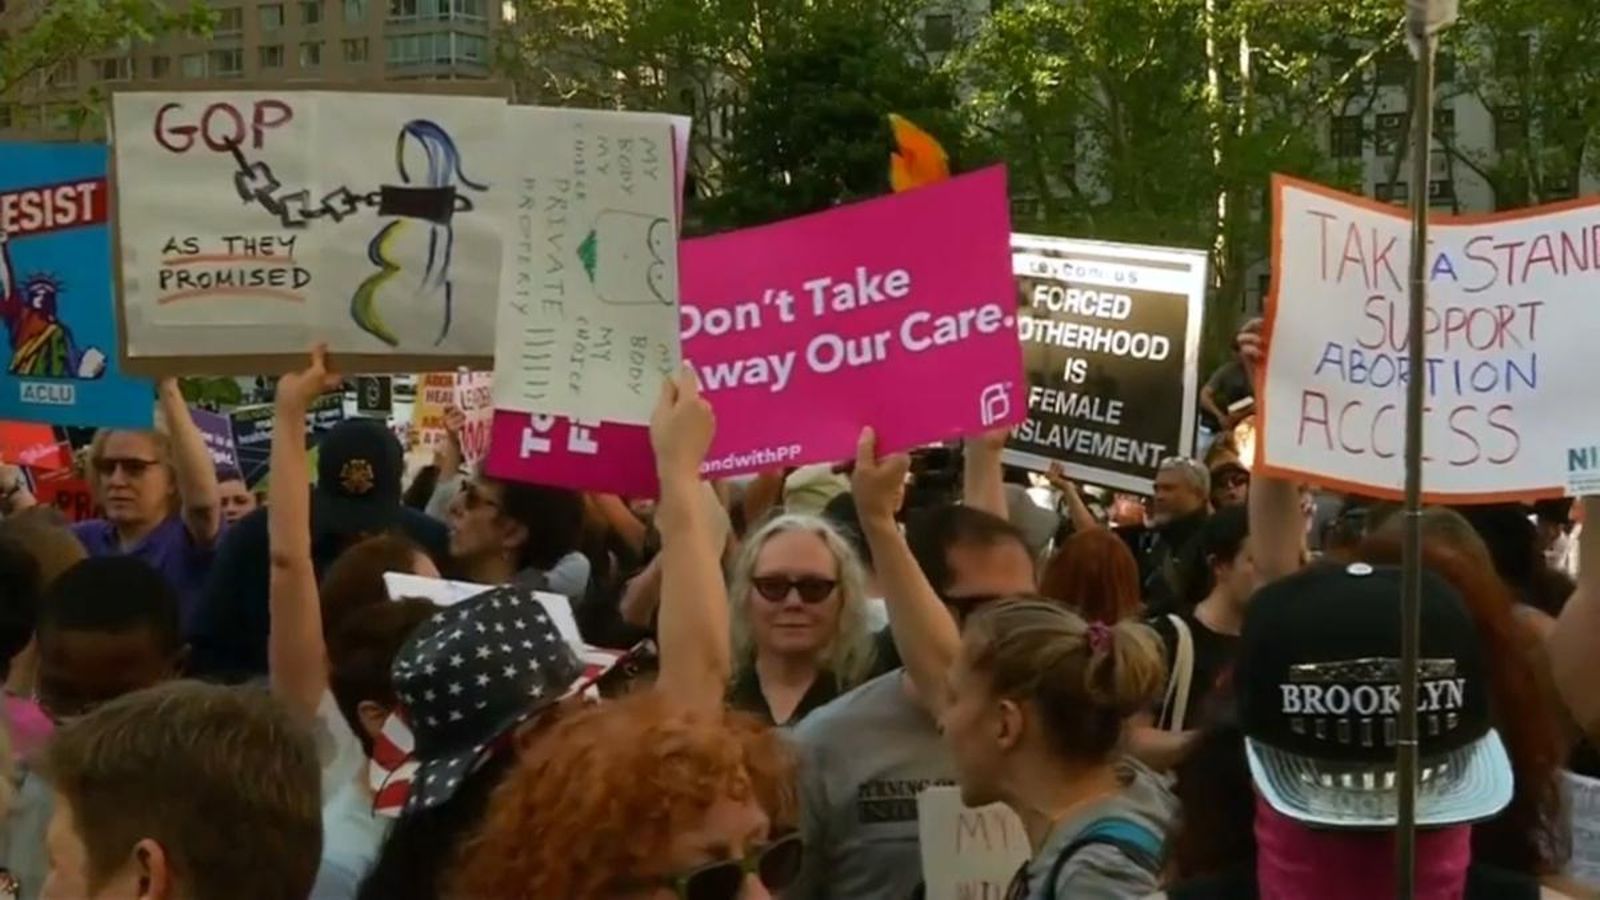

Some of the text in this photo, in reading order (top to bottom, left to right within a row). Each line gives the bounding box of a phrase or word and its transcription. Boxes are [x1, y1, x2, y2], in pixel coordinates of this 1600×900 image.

[0, 181, 97, 232] ESIST
[162, 234, 298, 256] AS THEY
[540, 177, 571, 317] PRIVATE
[1307, 209, 1434, 293] TAK
[159, 266, 312, 291] PROMISED
[803, 266, 911, 317] Take
[1033, 284, 1132, 320] FORCED
[680, 303, 1015, 394] way Our Care.
[1018, 316, 1170, 361] OTHERHOOD
[1064, 357, 1088, 384] IS
[22, 383, 74, 404] ACLU
[1028, 386, 1124, 426] FEMALE
[1009, 417, 1166, 469] NSLAVEMENT
[1297, 389, 1521, 466] ACCSS
[701, 444, 802, 473] andwithPP
[1567, 445, 1598, 472] NI
